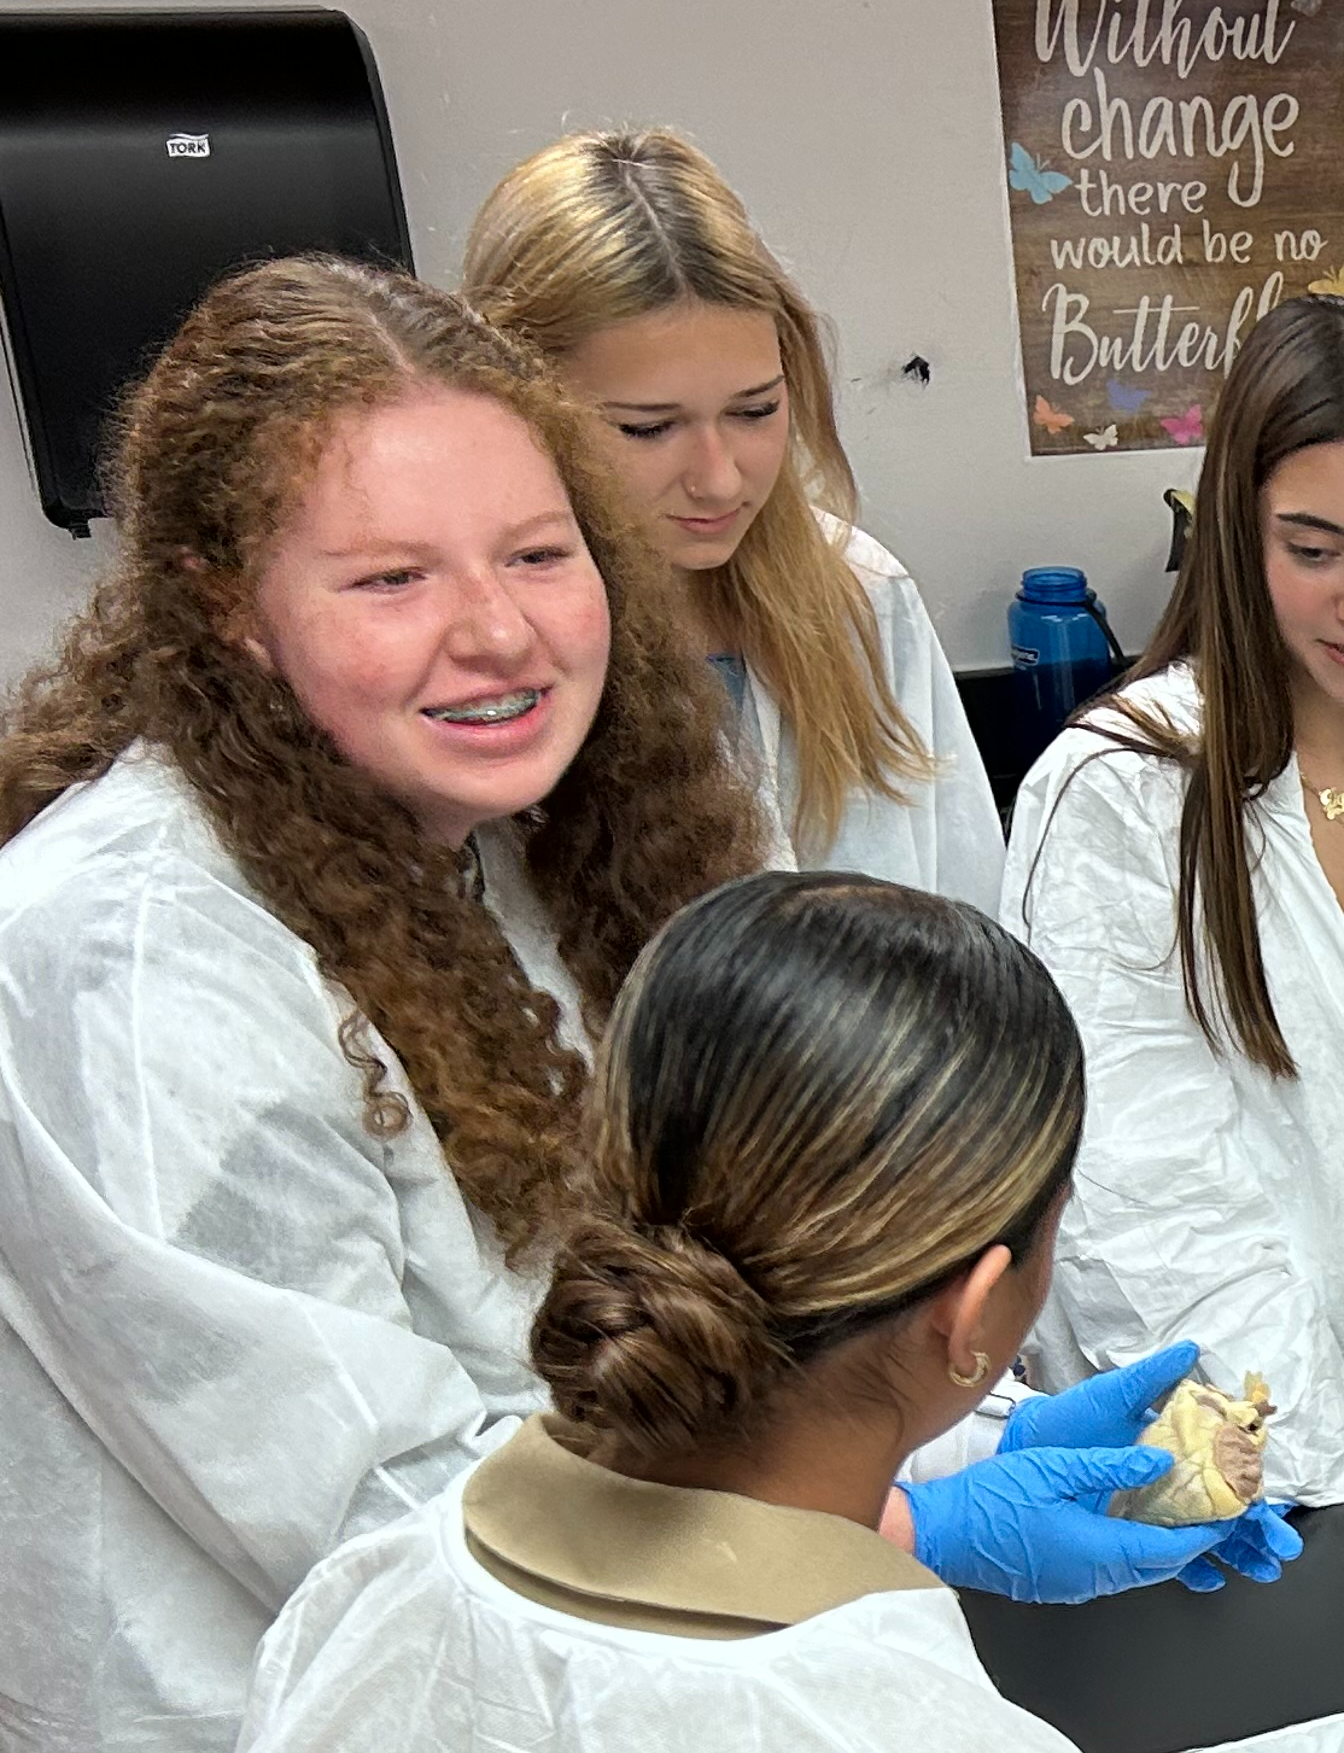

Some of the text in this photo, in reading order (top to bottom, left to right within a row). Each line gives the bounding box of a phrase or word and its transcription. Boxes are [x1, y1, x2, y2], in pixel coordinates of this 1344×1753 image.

[1035, 0, 1295, 78] Without
[169, 142, 206, 154] TORK
[1062, 67, 1299, 207] change
[1074, 169, 1207, 216] there
[1051, 219, 1328, 269] would be no
